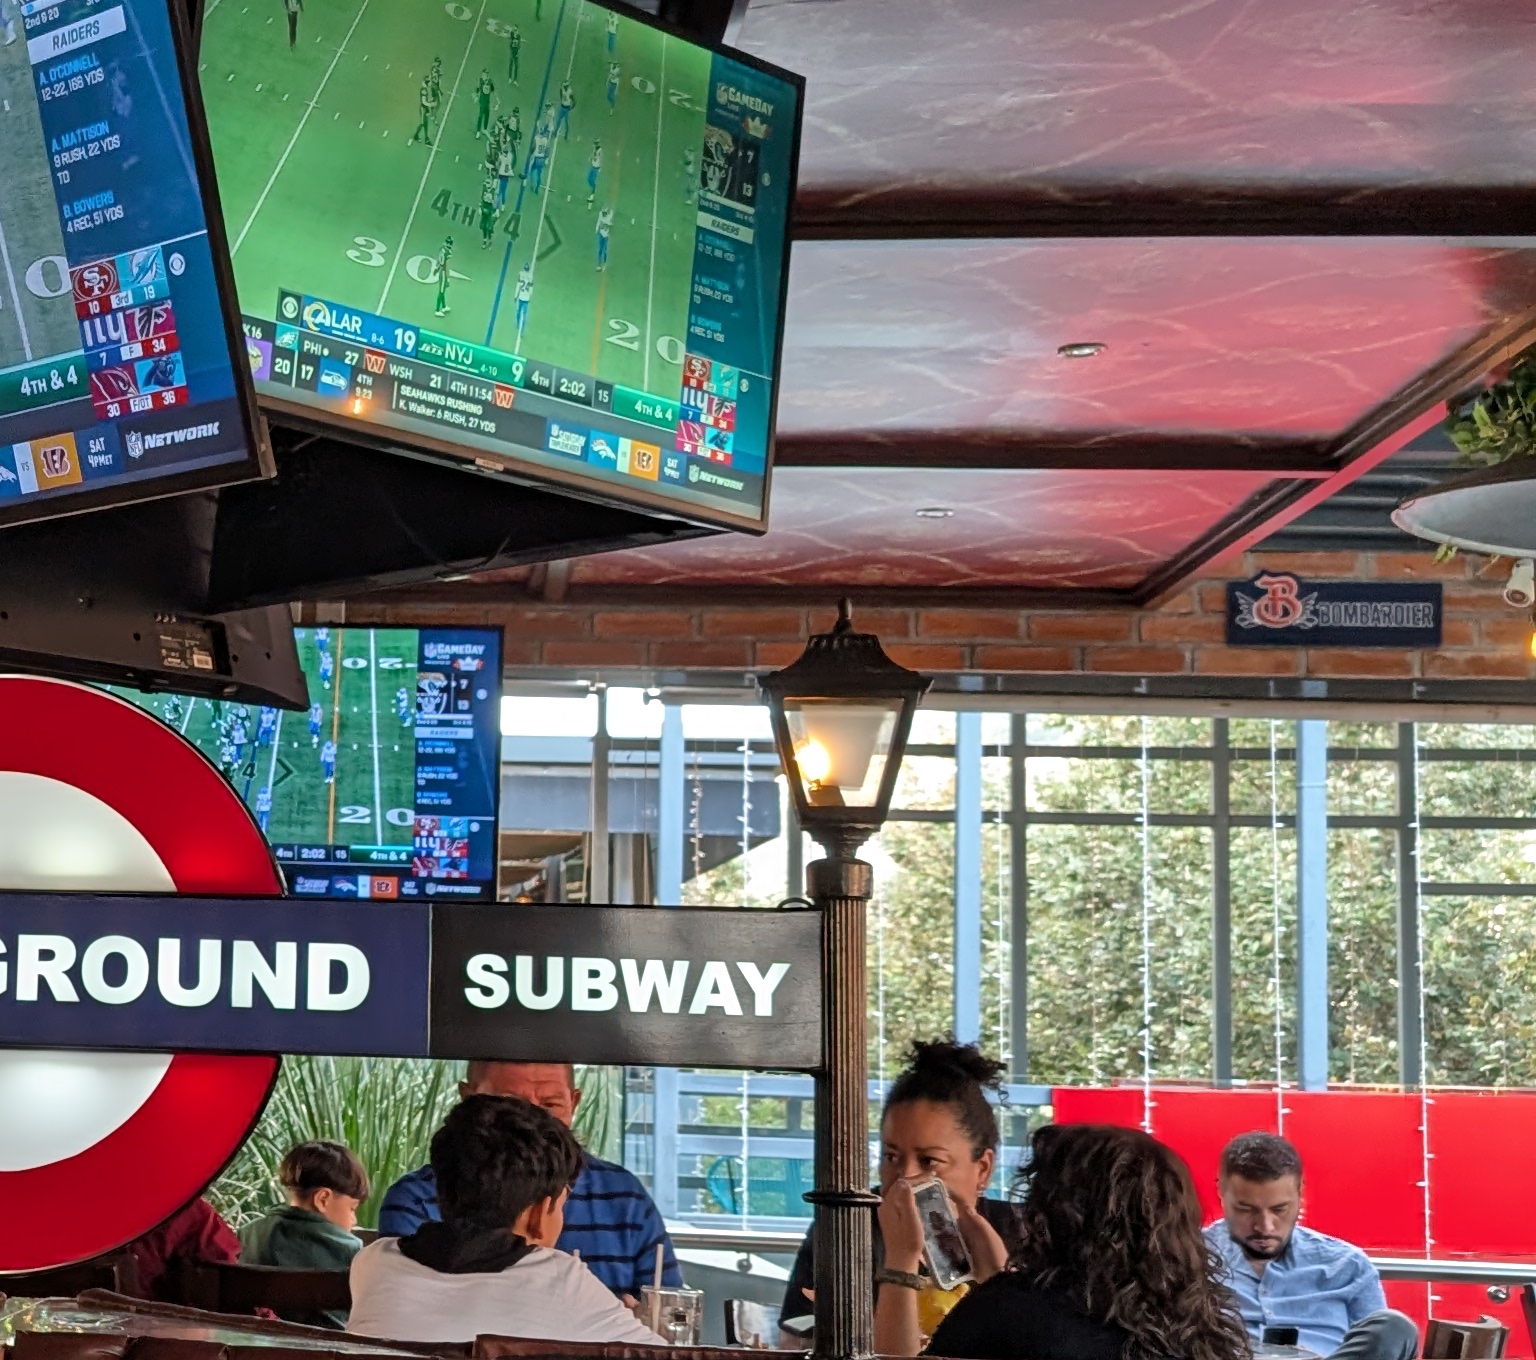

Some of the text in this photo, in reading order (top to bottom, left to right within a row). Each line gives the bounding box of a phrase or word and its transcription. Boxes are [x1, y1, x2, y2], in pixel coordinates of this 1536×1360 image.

[52, 20, 100, 51] RAIDERS
[86, 68, 105, 87] YDS
[728, 87, 773, 117] GAMEDAY
[61, 121, 110, 148] MATTISON
[102, 134, 121, 152] YDS
[746, 150, 754, 164] 7
[105, 205, 124, 222] YDS
[88, 284, 155, 314] 10 3rd 19
[251, 326, 263, 340] 16
[331, 309, 363, 335] LAR
[394, 327, 416, 353] 19
[99, 338, 166, 367] 7 F 34
[303, 340, 359, 367] PHI 27
[444, 342, 474, 366] NYJ
[480, 364, 498, 377] 4-10
[511, 361, 524, 383] 9
[20, 364, 78, 398] 4TH & 4
[274, 357, 314, 381] 20 17
[356, 373, 373, 387] 4TH
[389, 363, 492, 403] WSH 21 4TH 11:54
[531, 370, 610, 403] 4TH 2:02 15
[107, 404, 121, 418] 30
[162, 391, 176, 406] 36
[400, 384, 483, 416] SEAHAWKS RUSHING
[634, 398, 673, 422] 4TH & 4
[408, 402, 436, 418] Walker:
[436, 408, 442, 420] 6
[443, 411, 467, 427] RUSH,
[468, 416, 479, 428] 27
[479, 419, 496, 433] YDS
[89, 436, 106, 453] SAT
[144, 421, 220, 450] NETWORK
[1318, 601, 1434, 628] BOMBARDIER
[437, 643, 486, 655] GAMEDAY
[276, 848, 347, 860] 4TH 2:02 15
[369, 850, 408, 861] 4TH & 4
[464, 953, 791, 1017] SUBWAY
